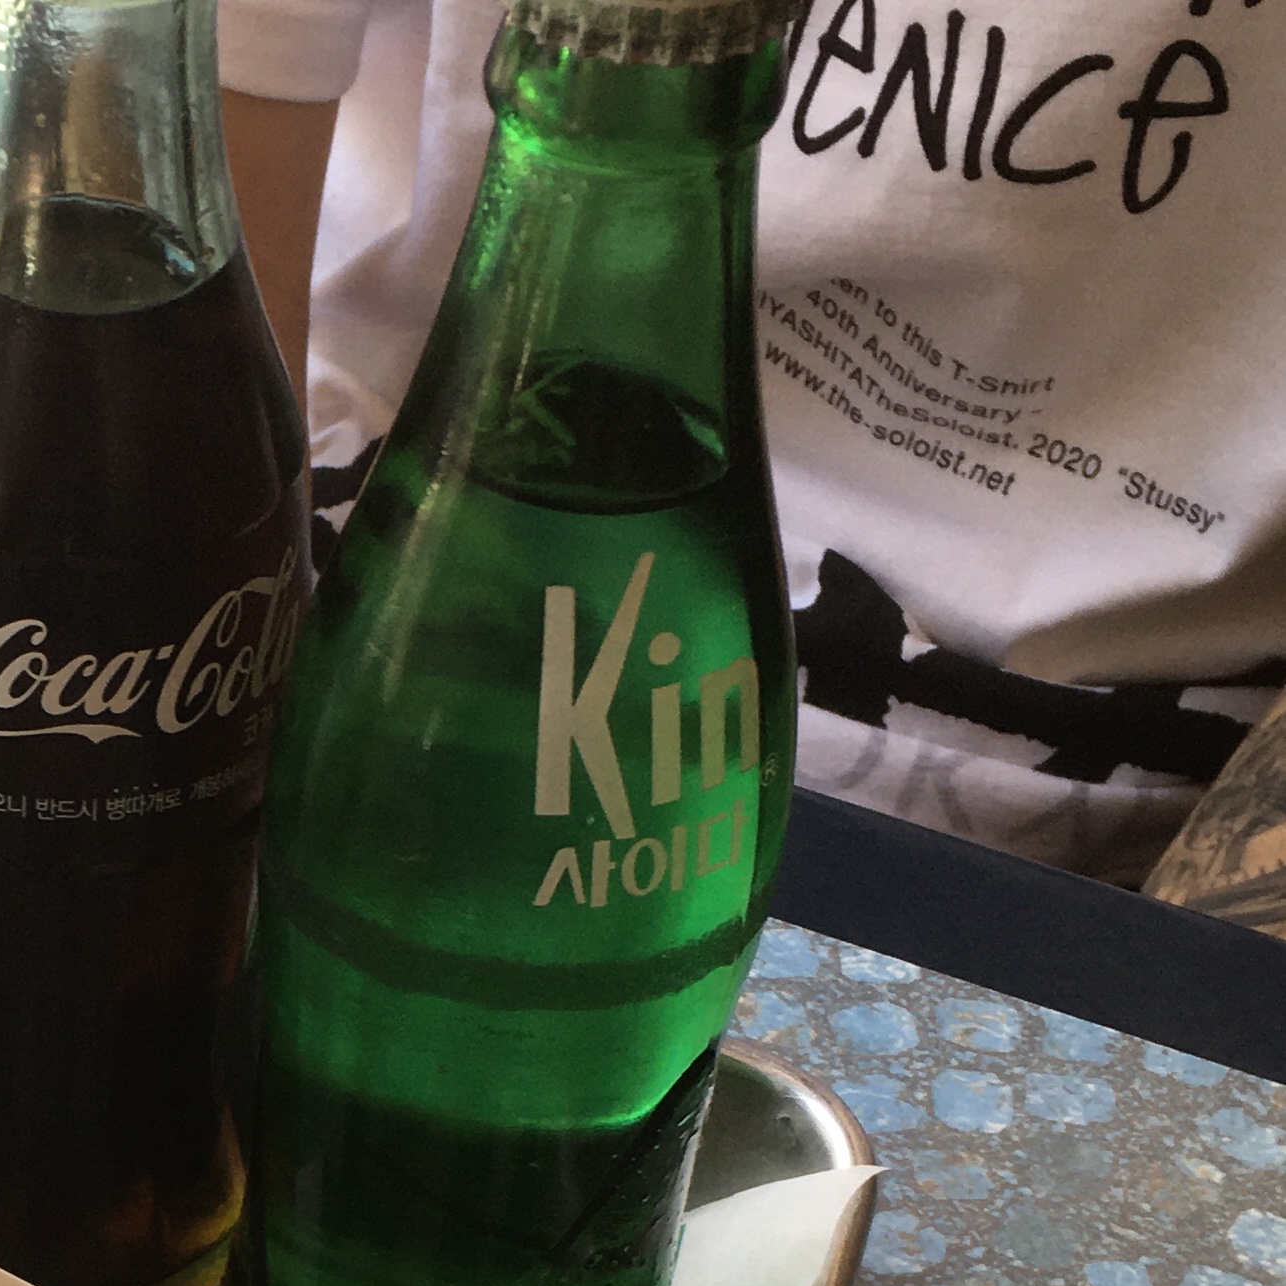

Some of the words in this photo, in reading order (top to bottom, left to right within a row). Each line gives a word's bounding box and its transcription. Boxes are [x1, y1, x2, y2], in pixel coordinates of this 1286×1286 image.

[806, 289, 860, 340] 40th
[861, 333, 1022, 424] Anniversary
[875, 298, 898, 328] to
[902, 319, 942, 367] this
[764, 340, 1016, 496] www.the-soloist.net
[1027, 432, 1103, 480] 2020
[534, 552, 761, 839] Kin
[35, 797, 98, 821] 반드시
[532, 798, 748, 908] 사이다
